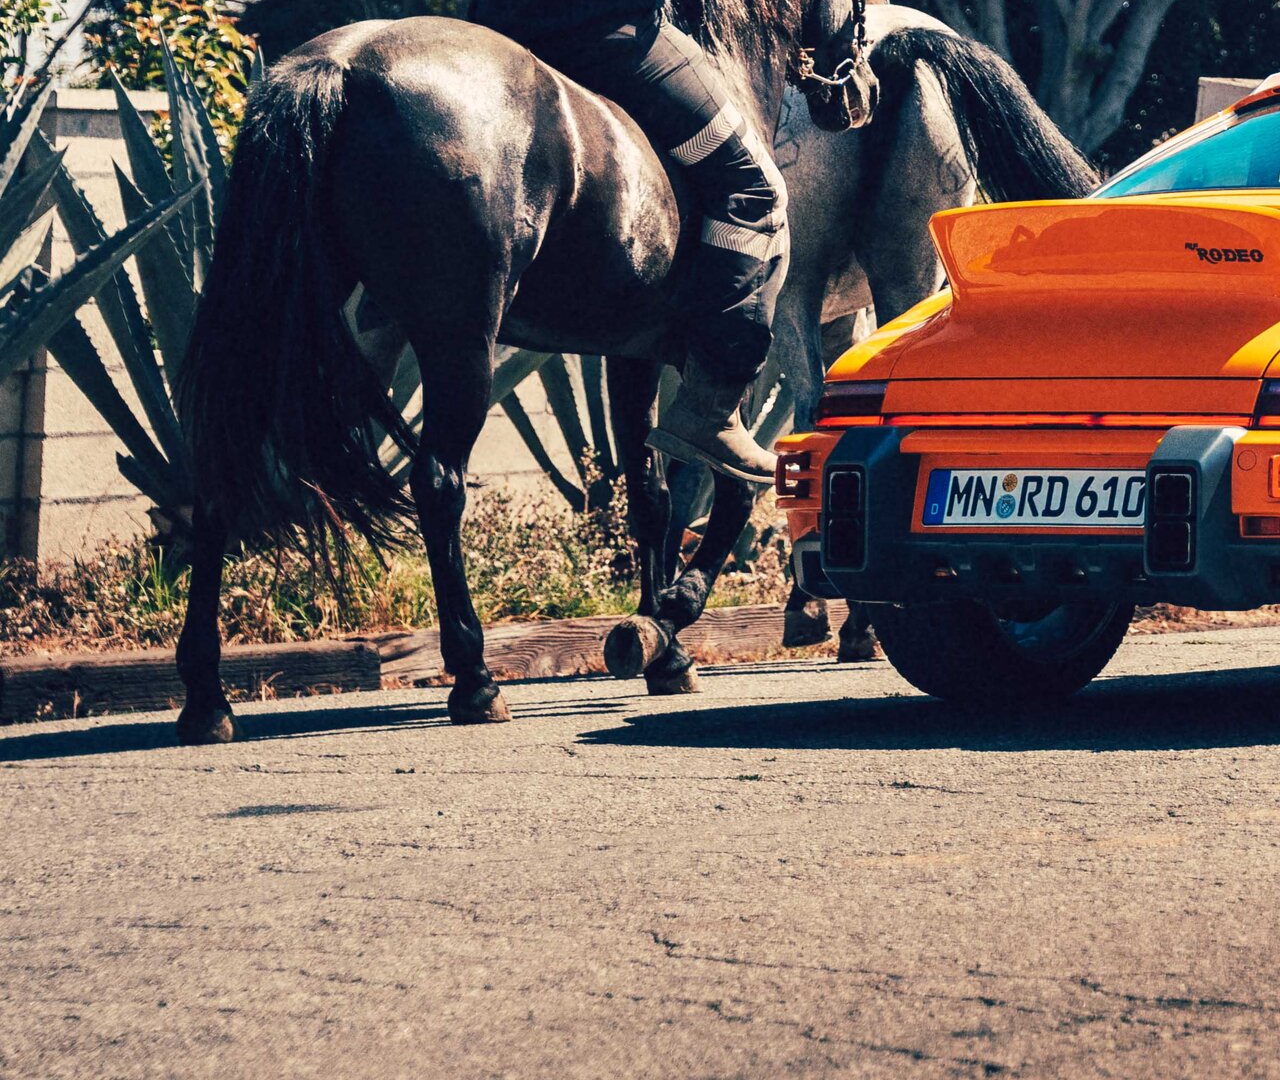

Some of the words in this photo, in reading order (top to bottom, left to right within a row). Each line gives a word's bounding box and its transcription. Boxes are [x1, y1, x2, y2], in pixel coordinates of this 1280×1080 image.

[1197, 247, 1264, 265] RODEO
[930, 503, 938, 515] D
[946, 476, 998, 517] MN
[1017, 476, 1069, 517] RD
[1075, 476, 1146, 518] 610
